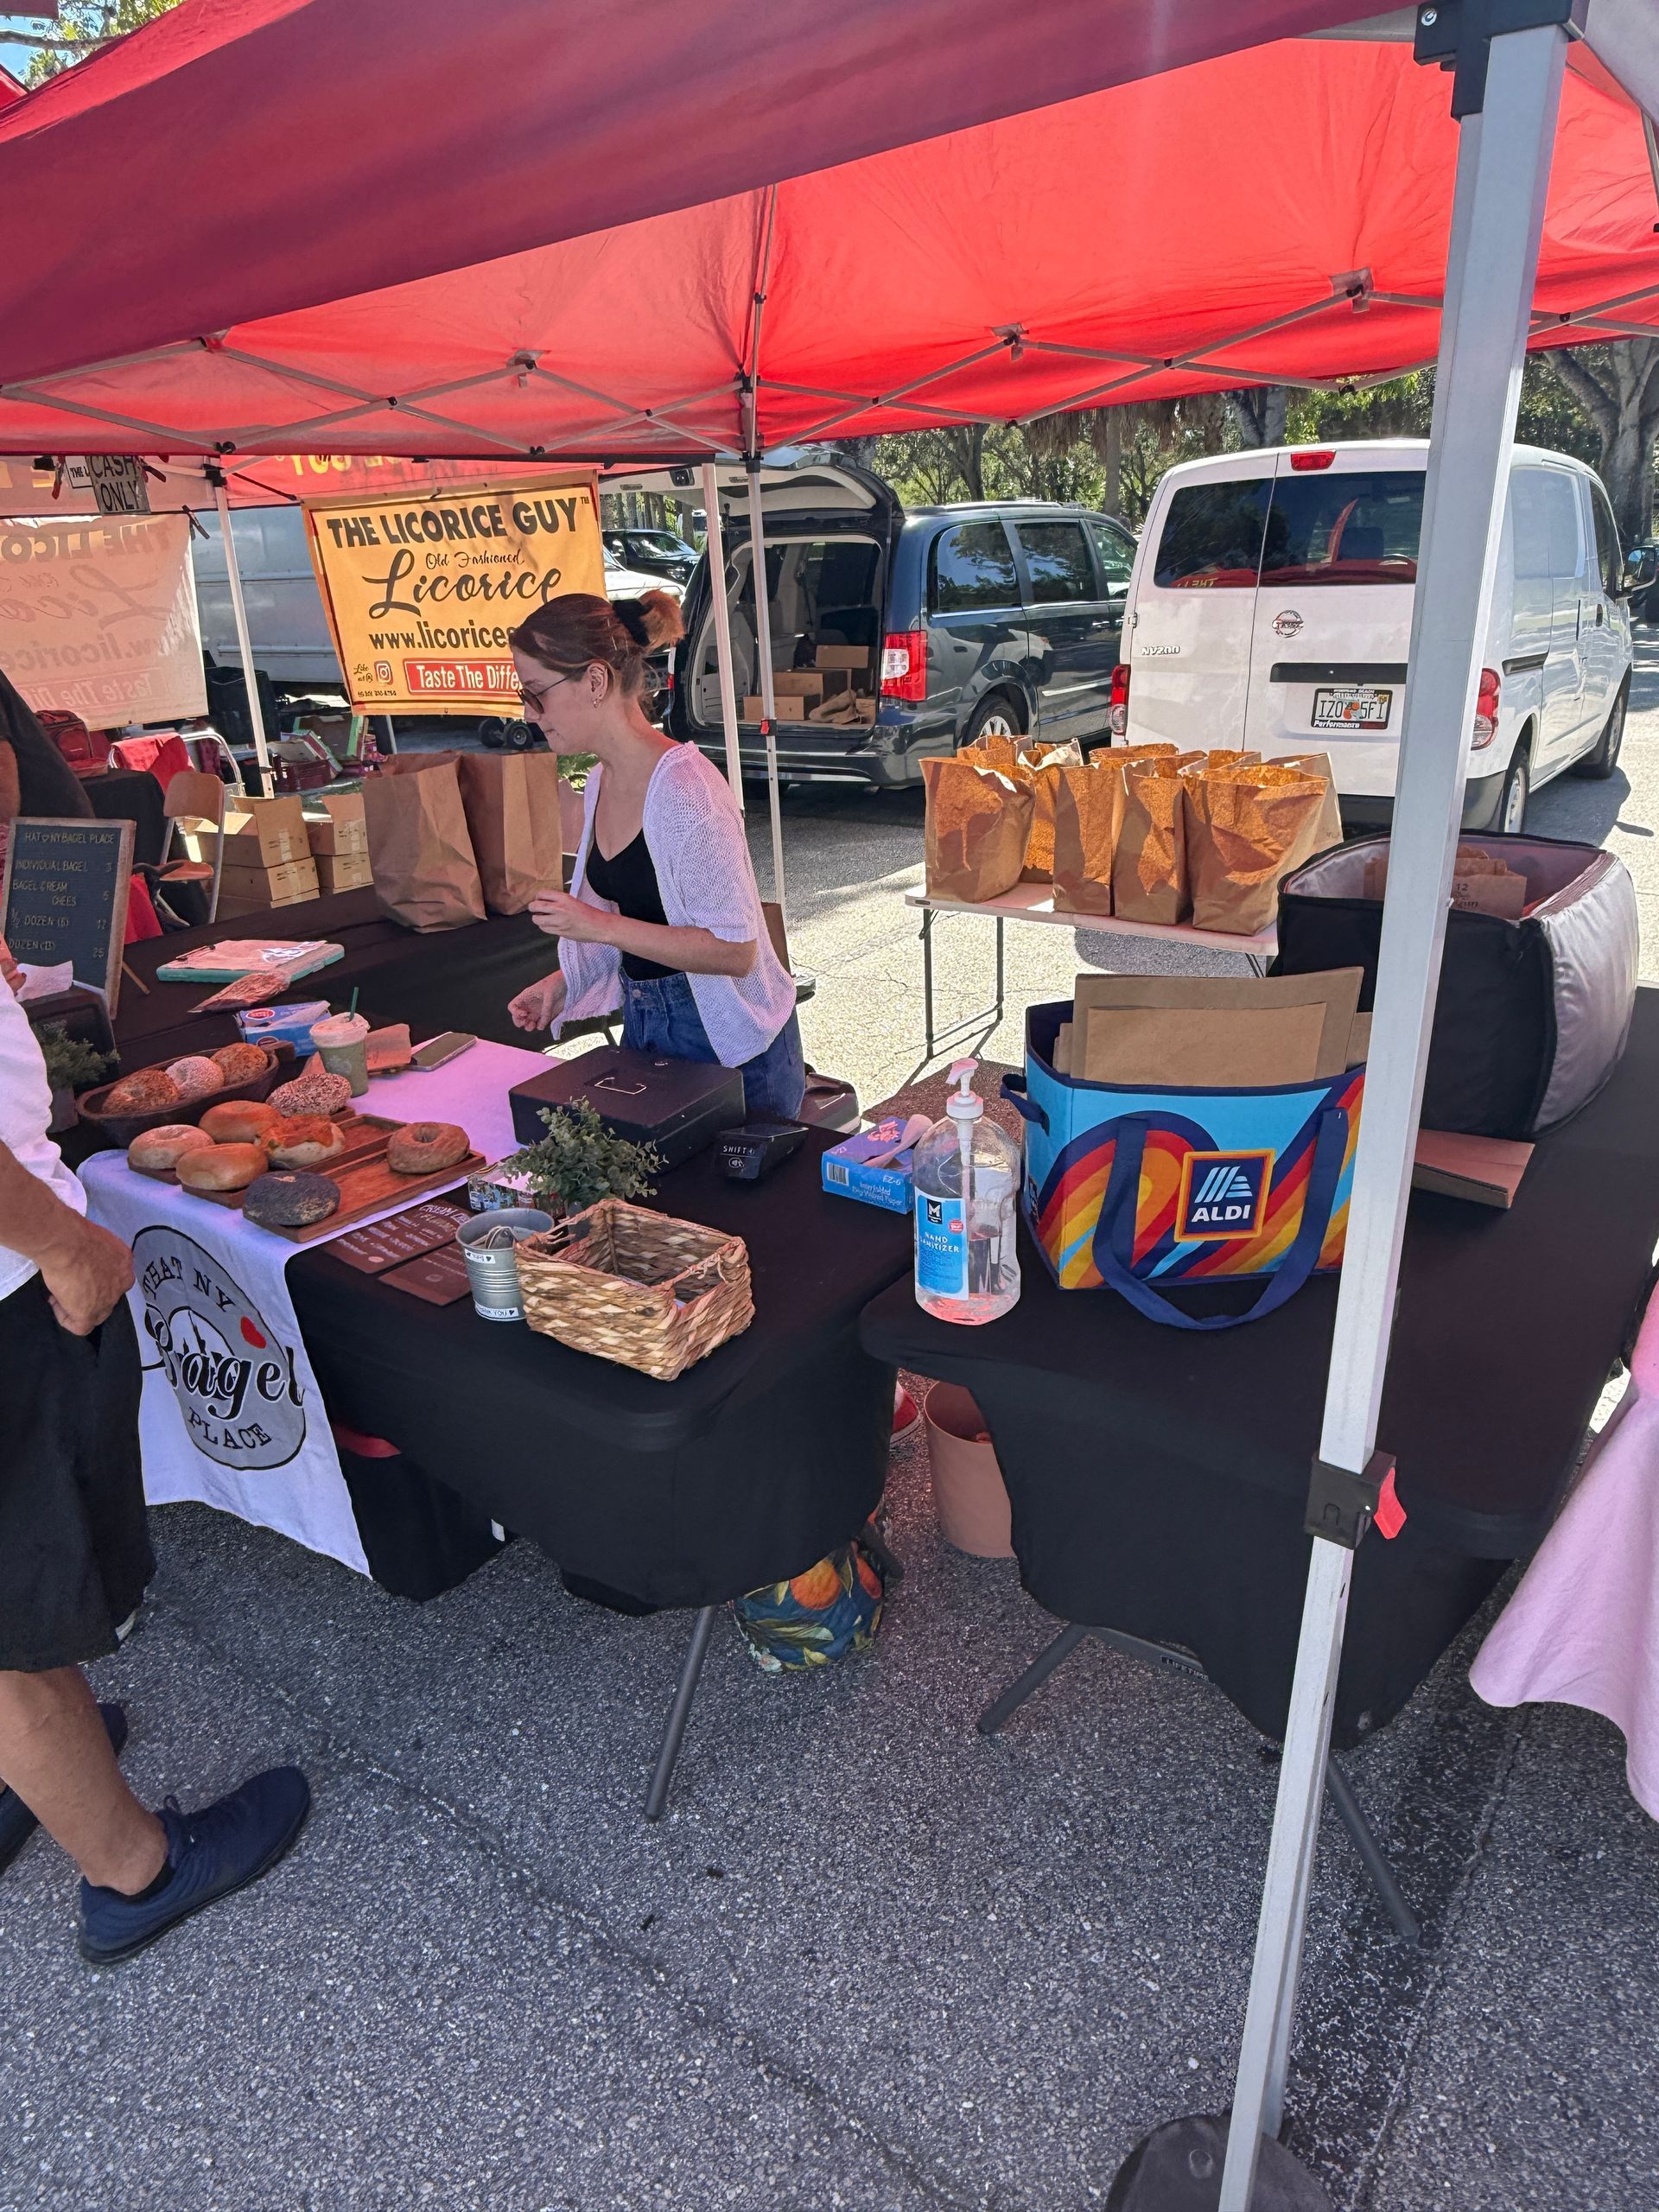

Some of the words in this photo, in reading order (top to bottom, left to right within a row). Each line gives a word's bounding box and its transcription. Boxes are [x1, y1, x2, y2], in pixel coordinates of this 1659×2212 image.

[100, 480, 140, 512] ONLY
[327, 516, 381, 549] THE
[380, 505, 507, 544] LICORICE
[512, 497, 577, 536] GUY
[425, 552, 450, 570] Old
[454, 549, 525, 569] Fashioned
[361, 548, 562, 620] Licorice
[416, 664, 454, 690] Taste
[455, 664, 484, 690] The
[24, 916, 54, 926] DOZEN
[1192, 1205, 1250, 1222] ALDI
[919, 1236, 960, 1253] SANITIZER
[925, 1231, 948, 1243] HAND
[143, 1256, 184, 1300] THAT
[188, 1407, 272, 1450] PLACE
